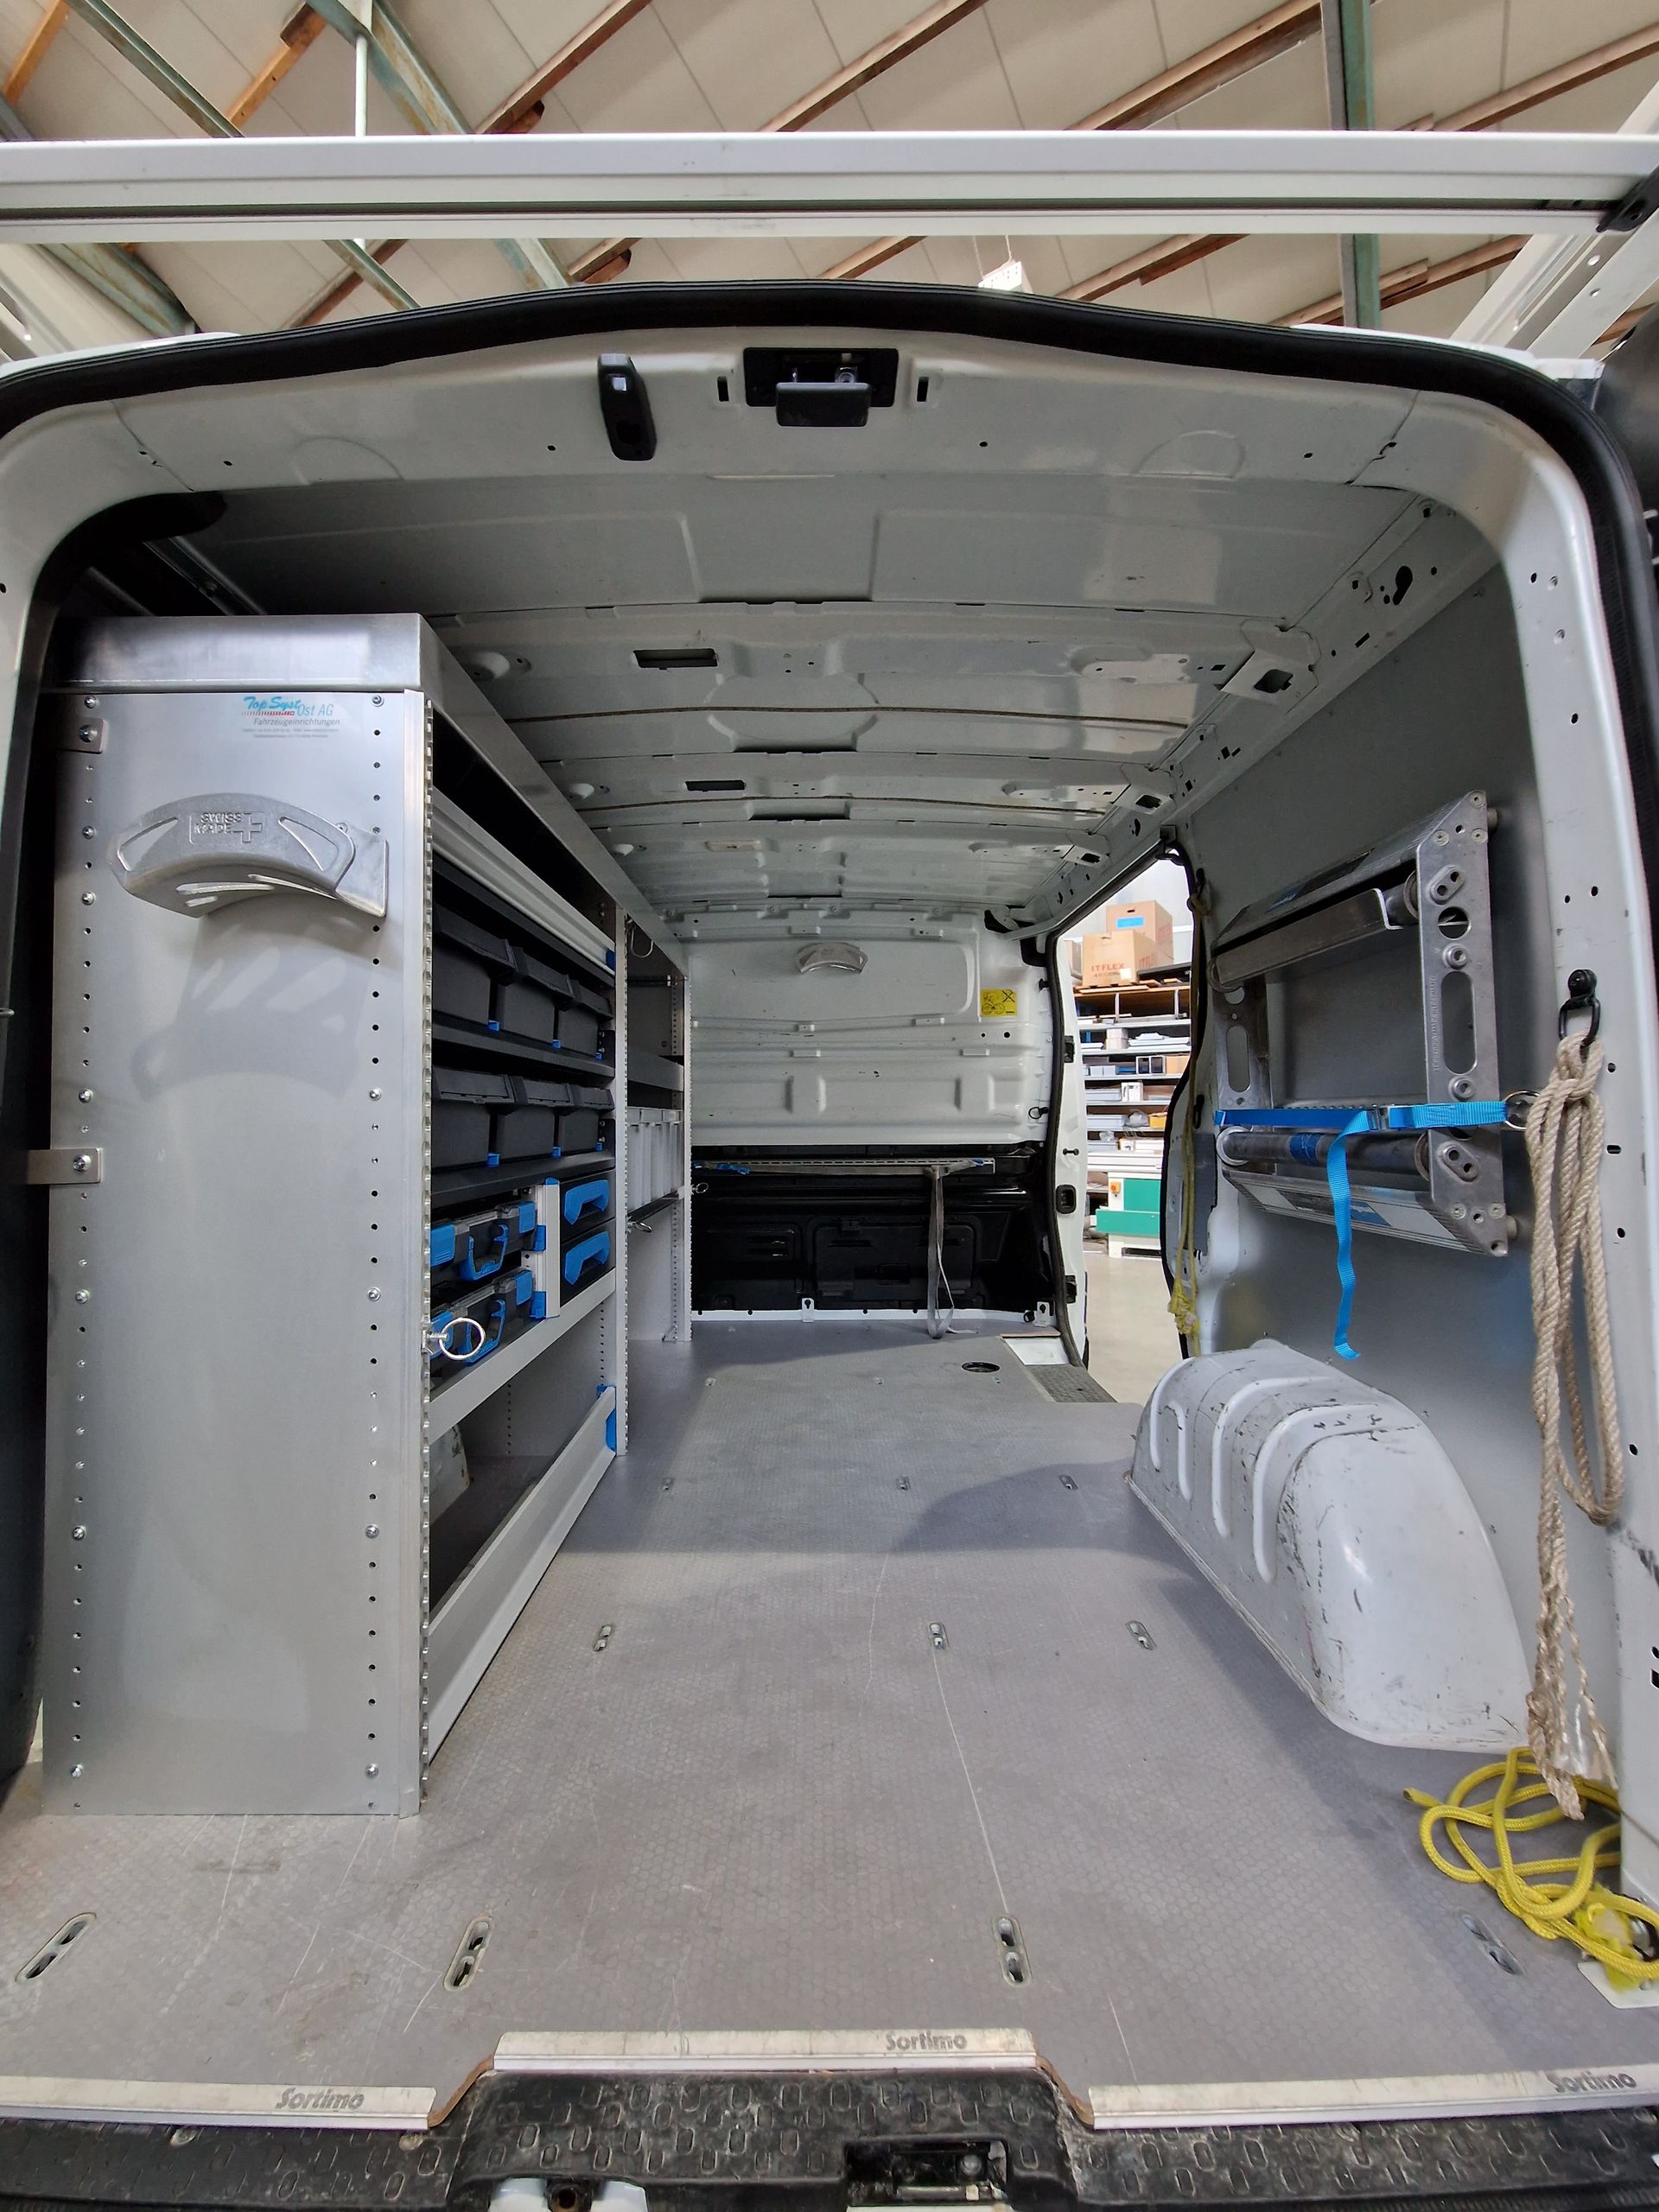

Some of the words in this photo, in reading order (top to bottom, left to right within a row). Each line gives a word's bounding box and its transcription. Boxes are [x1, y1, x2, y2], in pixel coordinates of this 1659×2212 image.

[244, 696, 267, 710] Top
[269, 696, 301, 711] Syst
[297, 703, 315, 716] Ost
[318, 703, 334, 716] AG
[253, 717, 340, 726] Fahrzeugeinrichtungen
[200, 812, 242, 823] SWISS
[194, 823, 232, 834] MADE
[885, 2031, 967, 2051] Sortimo
[1545, 2071, 1637, 2094] Sortimo
[276, 2087, 365, 2110] Sortimo
